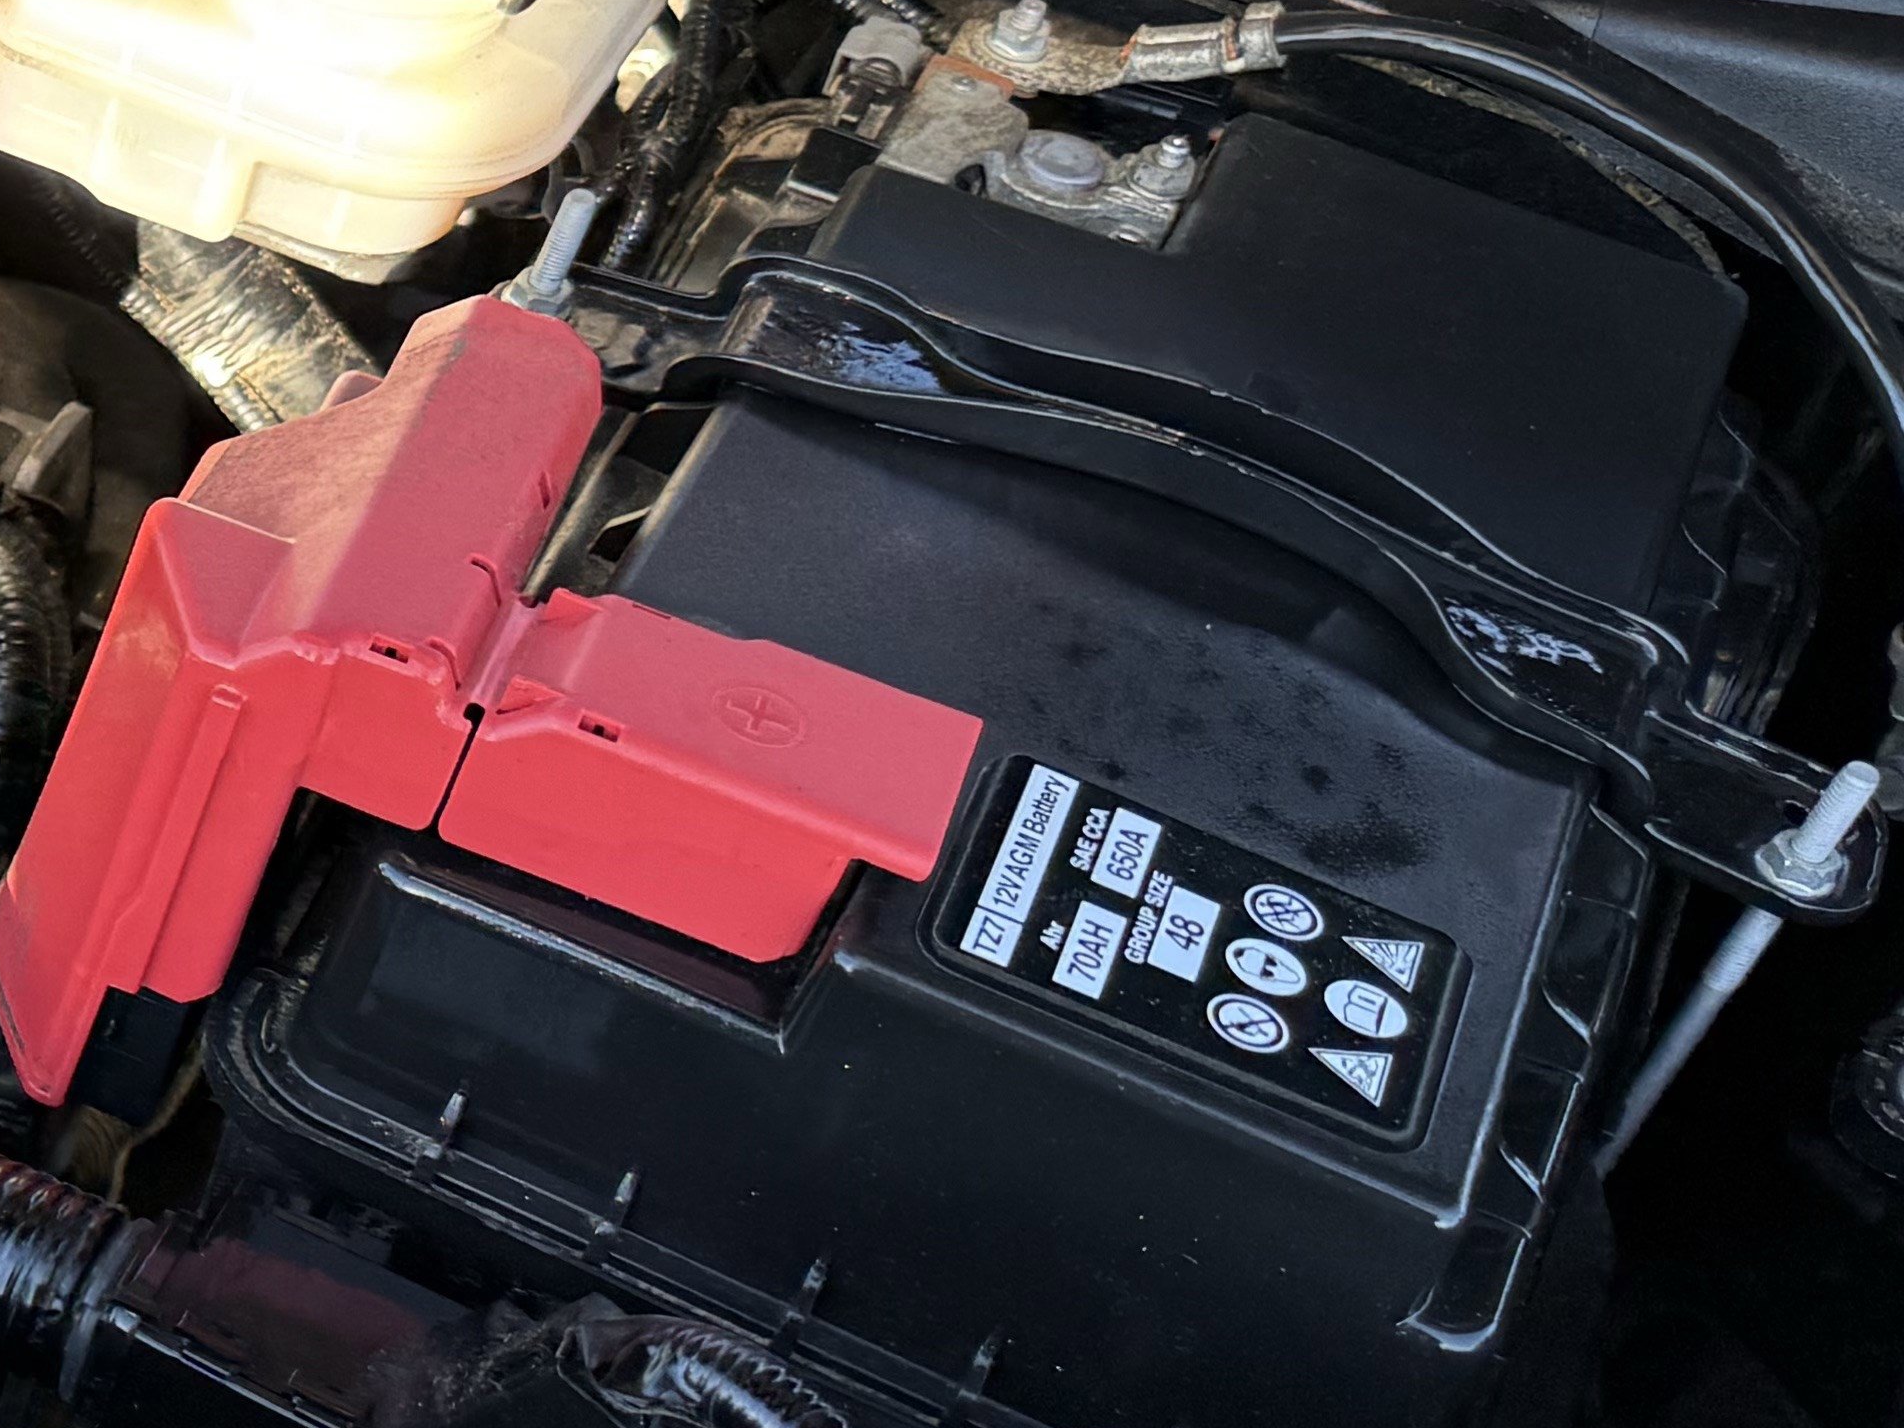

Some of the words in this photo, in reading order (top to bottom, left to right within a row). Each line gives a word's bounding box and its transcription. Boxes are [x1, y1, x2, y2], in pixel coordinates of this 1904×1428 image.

[1023, 775, 1070, 835] Battery
[1083, 808, 1111, 840] CCA
[1006, 832, 1041, 881] AGM
[1070, 837, 1099, 872] SAE
[1106, 828, 1149, 881] 650A
[993, 874, 1021, 909] 12V
[1041, 920, 1066, 951] Ahr
[1123, 906, 1159, 964] GROUP
[1145, 870, 1174, 909] SIZE
[1164, 914, 1204, 952] 48
[1068, 919, 1114, 982] 70AH
